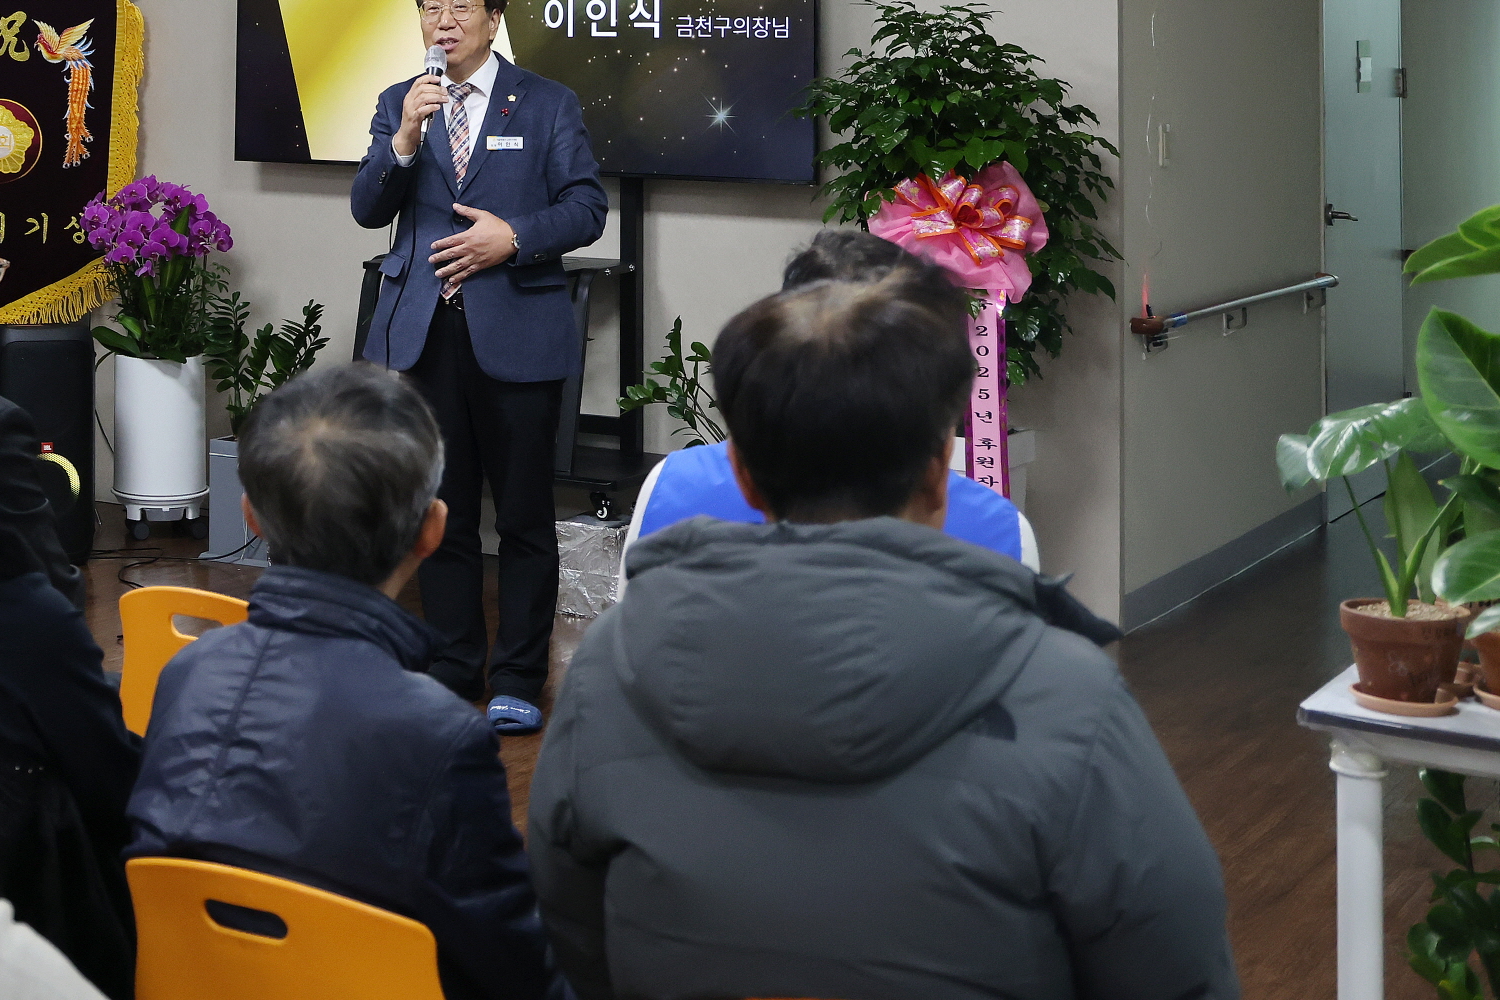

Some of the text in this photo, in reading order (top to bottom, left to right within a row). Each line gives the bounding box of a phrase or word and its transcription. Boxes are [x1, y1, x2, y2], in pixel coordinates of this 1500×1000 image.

[675, 16, 790, 39] 금천구의장님
[975, 325, 993, 424] 2025년
[975, 437, 999, 488] 후원자
